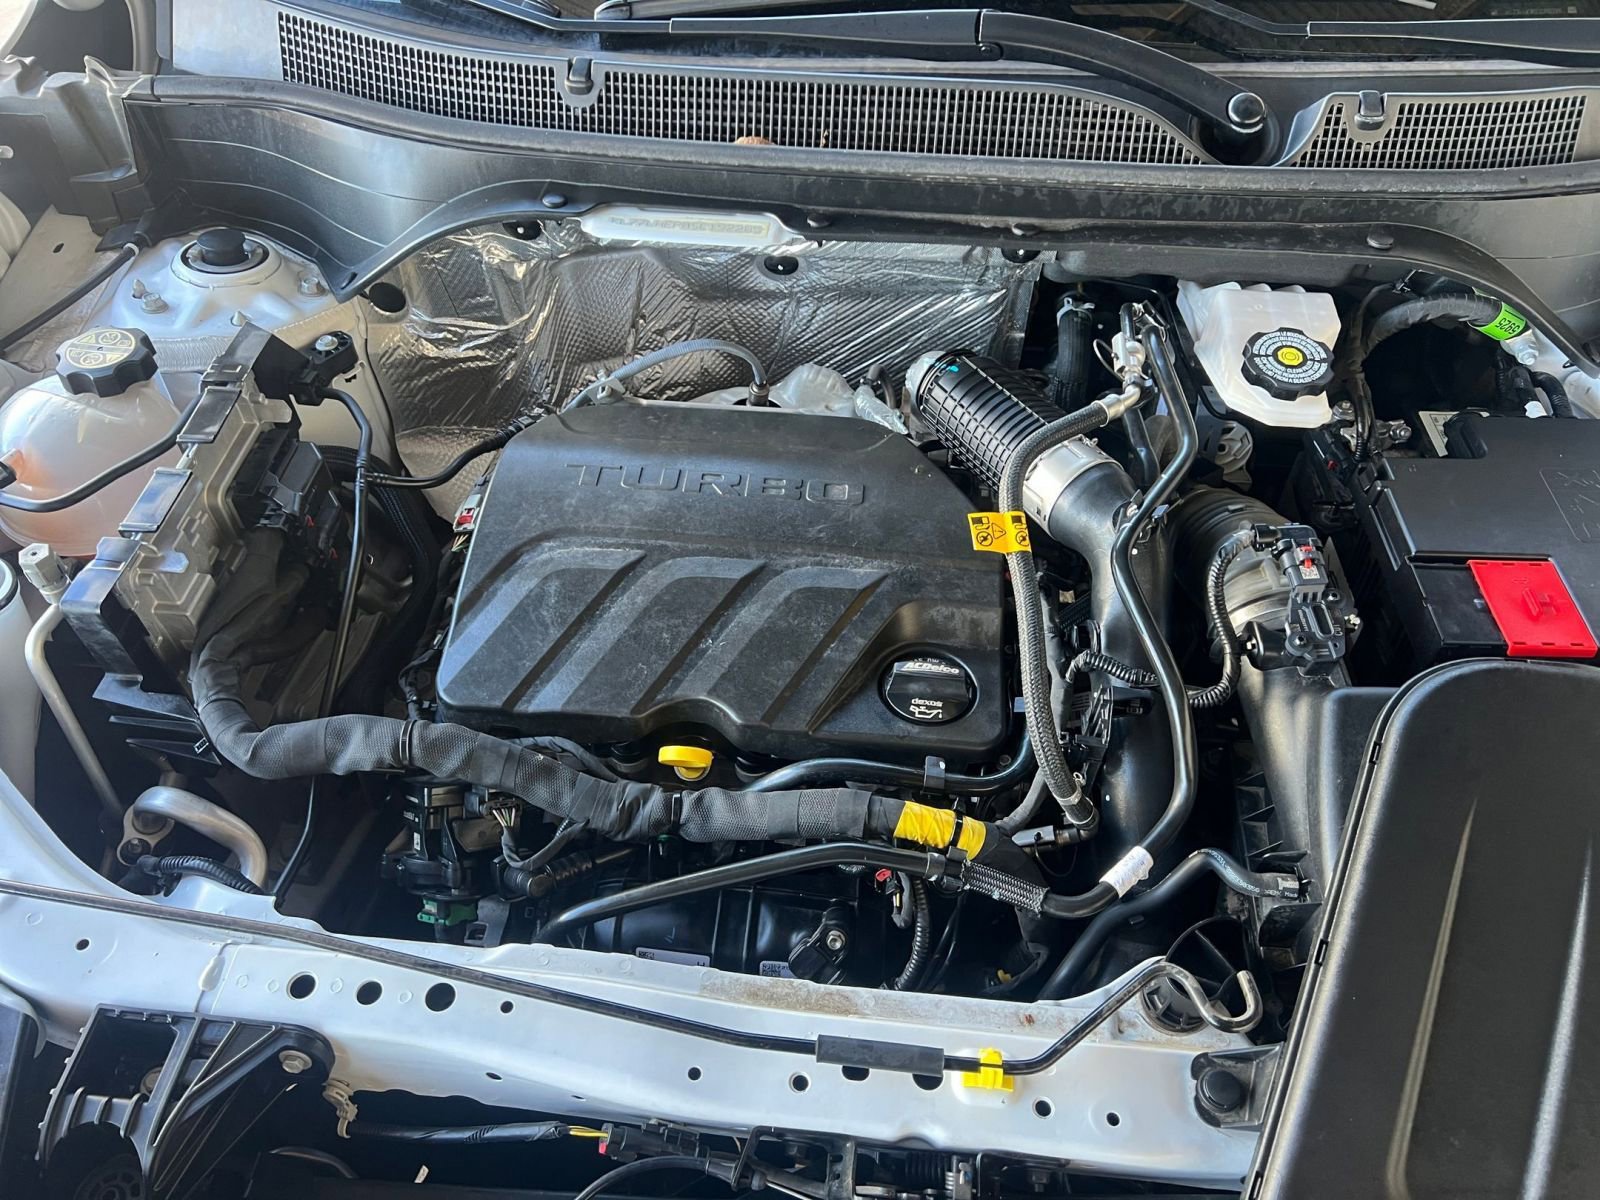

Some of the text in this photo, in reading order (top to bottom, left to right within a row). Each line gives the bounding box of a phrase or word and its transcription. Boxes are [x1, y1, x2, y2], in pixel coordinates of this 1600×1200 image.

[564, 463, 865, 505] TURBO
[903, 661, 959, 674] ACDelco
[911, 697, 943, 707] dexos
